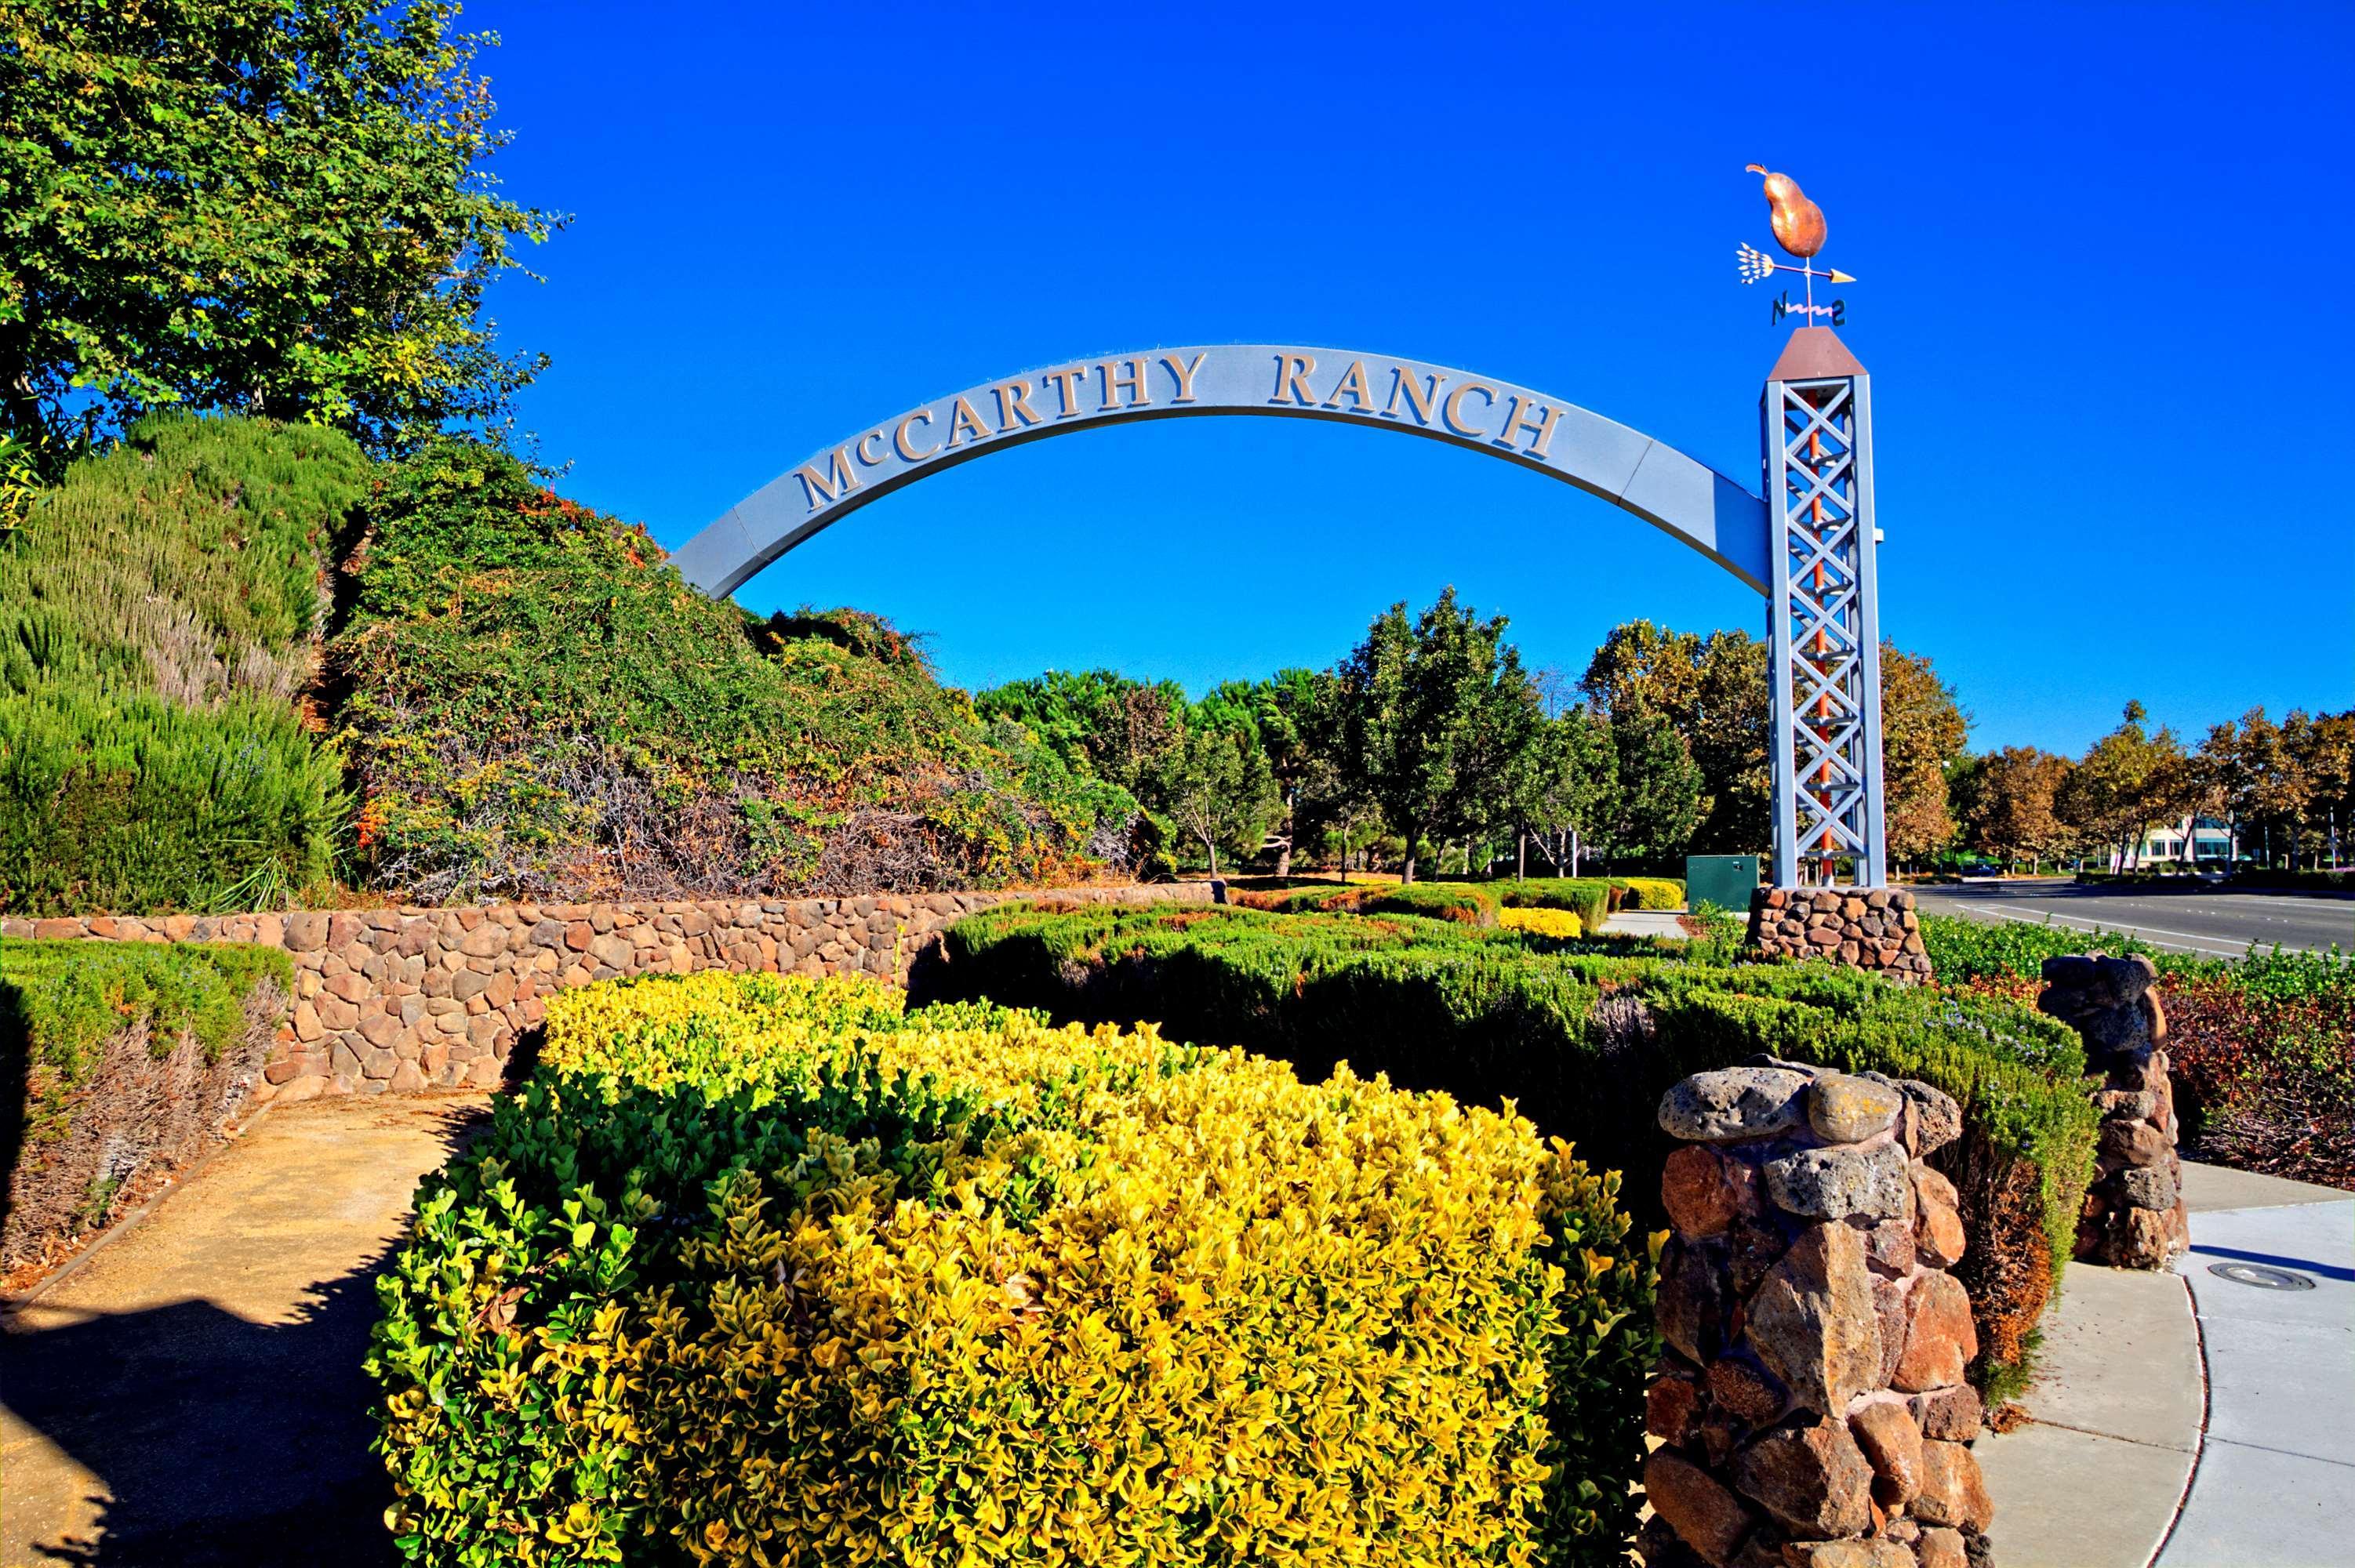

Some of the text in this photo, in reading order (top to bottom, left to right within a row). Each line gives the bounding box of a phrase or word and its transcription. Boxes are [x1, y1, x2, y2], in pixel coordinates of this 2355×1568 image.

[1772, 290, 1787, 326] N
[793, 352, 1567, 514] McCARTHY RANCH
